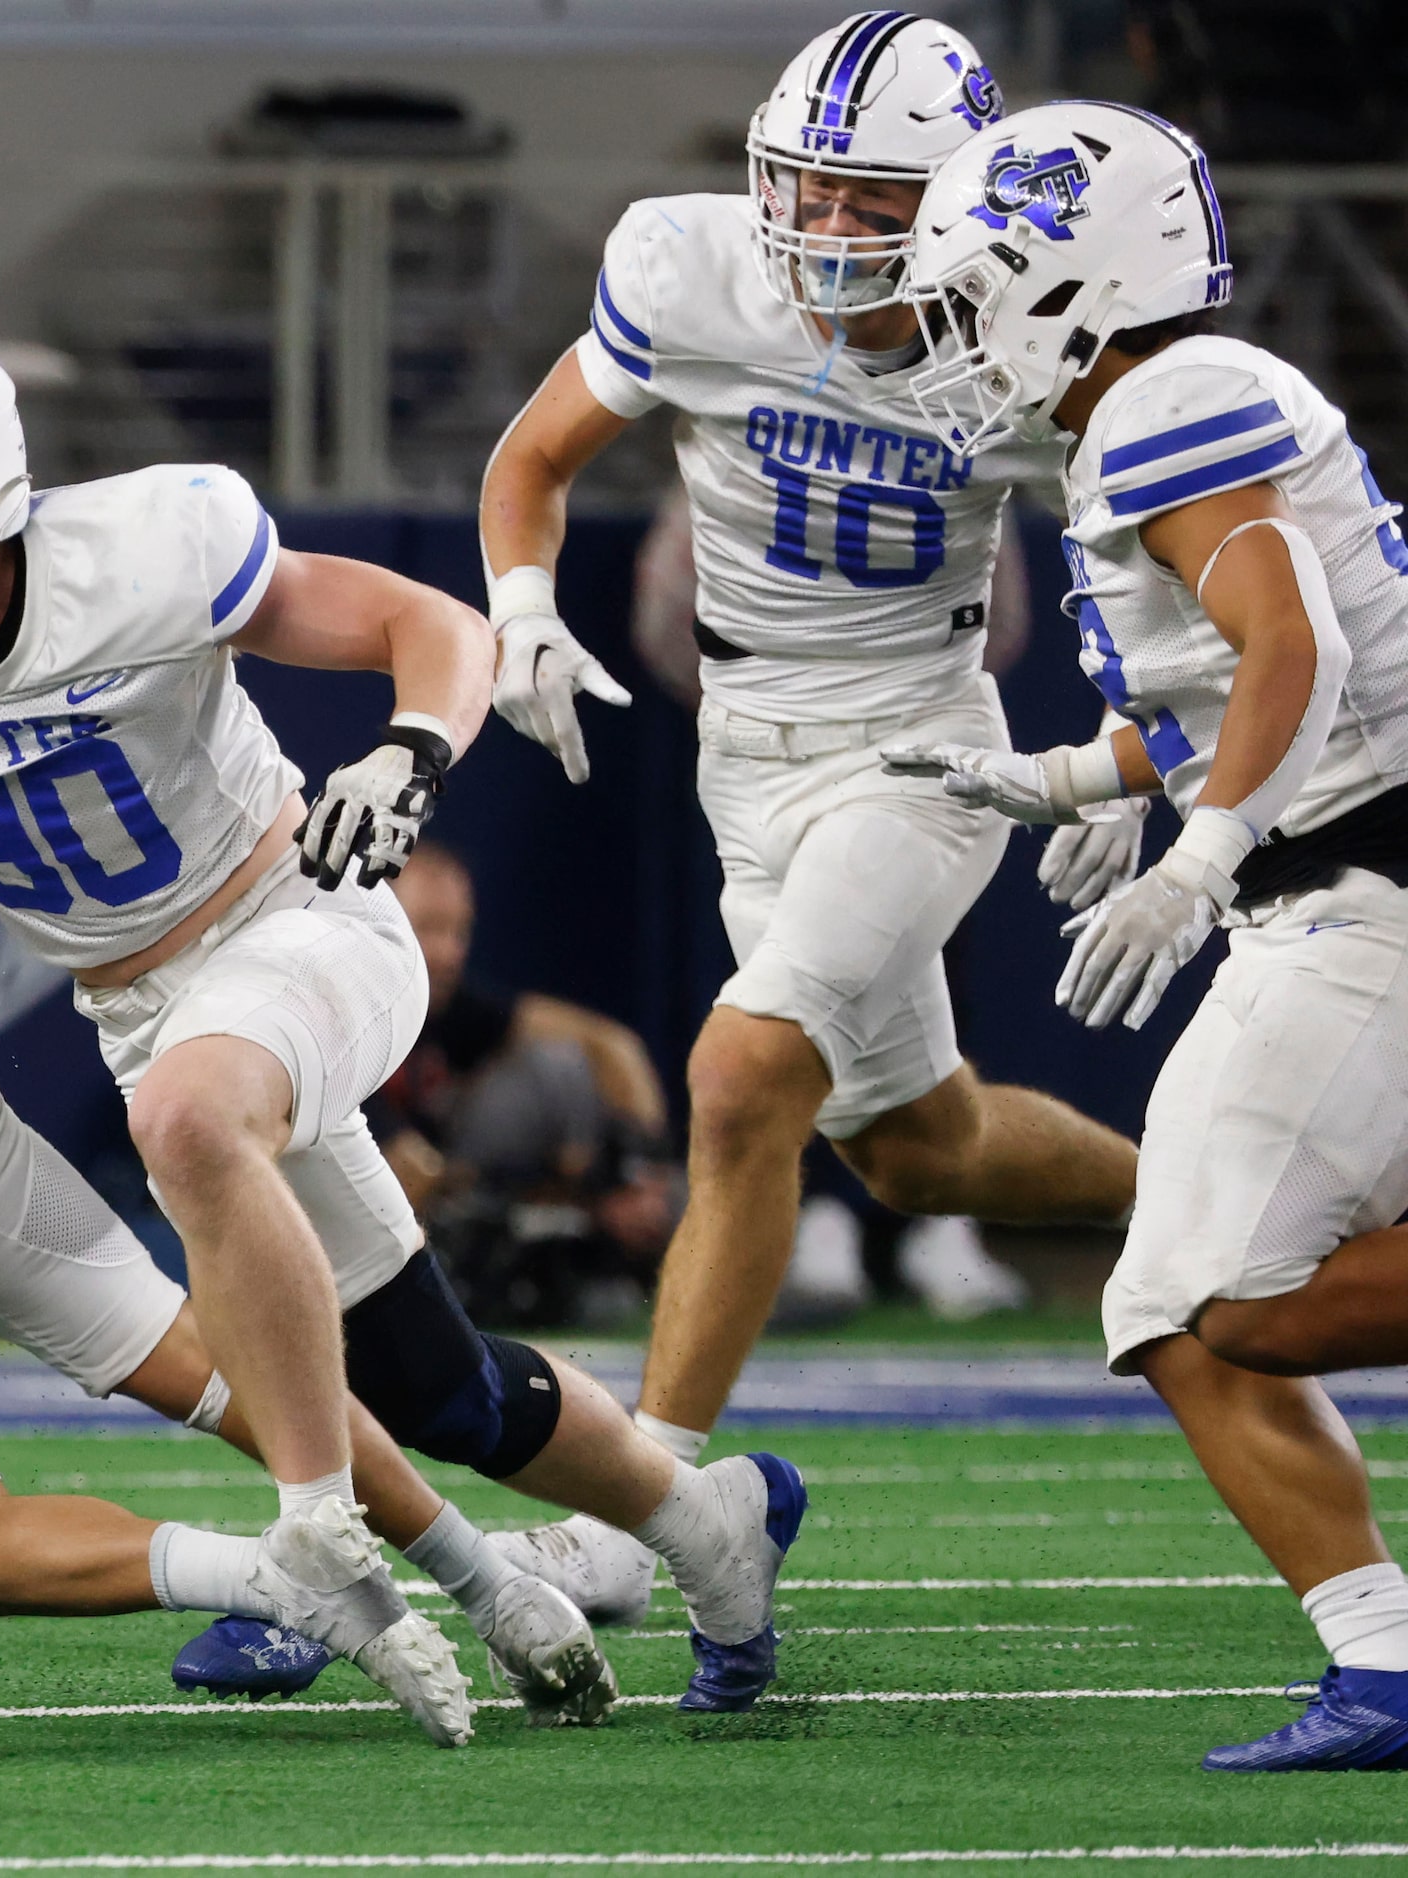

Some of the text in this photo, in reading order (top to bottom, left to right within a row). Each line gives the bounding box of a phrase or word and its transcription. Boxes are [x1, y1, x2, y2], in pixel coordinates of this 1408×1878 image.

[801, 126, 853, 155] TPW
[746, 406, 974, 491] GUNTER
[761, 457, 946, 588] 10
